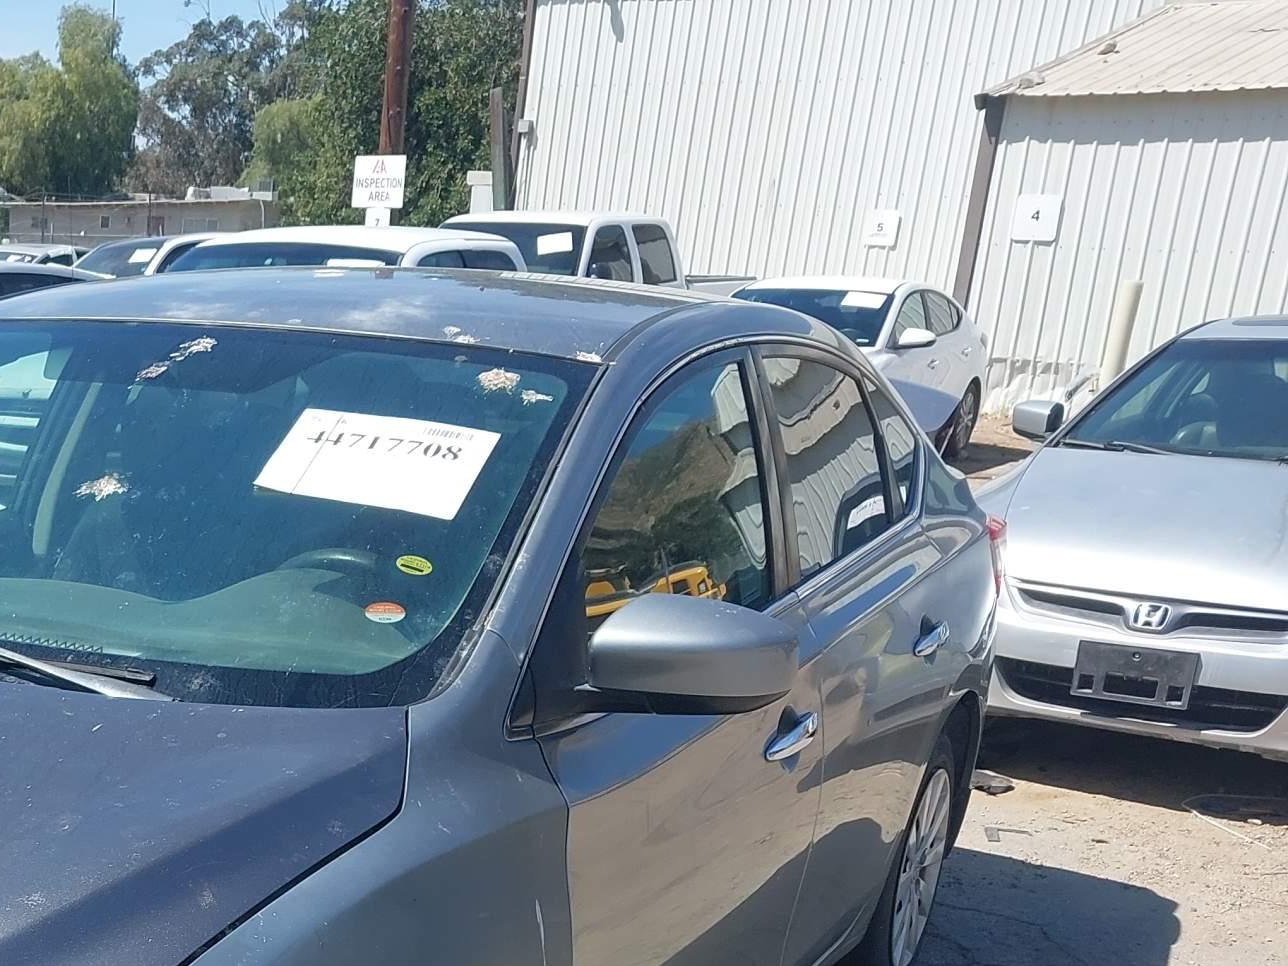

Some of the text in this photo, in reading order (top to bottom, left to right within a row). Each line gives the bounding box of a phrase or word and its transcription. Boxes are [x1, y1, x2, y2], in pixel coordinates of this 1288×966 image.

[355, 178, 403, 189] INSPECTION
[368, 191, 390, 201] AREA
[1031, 210, 1040, 222] 4
[876, 222, 885, 232] 5
[307, 430, 463, 460] 44717708
